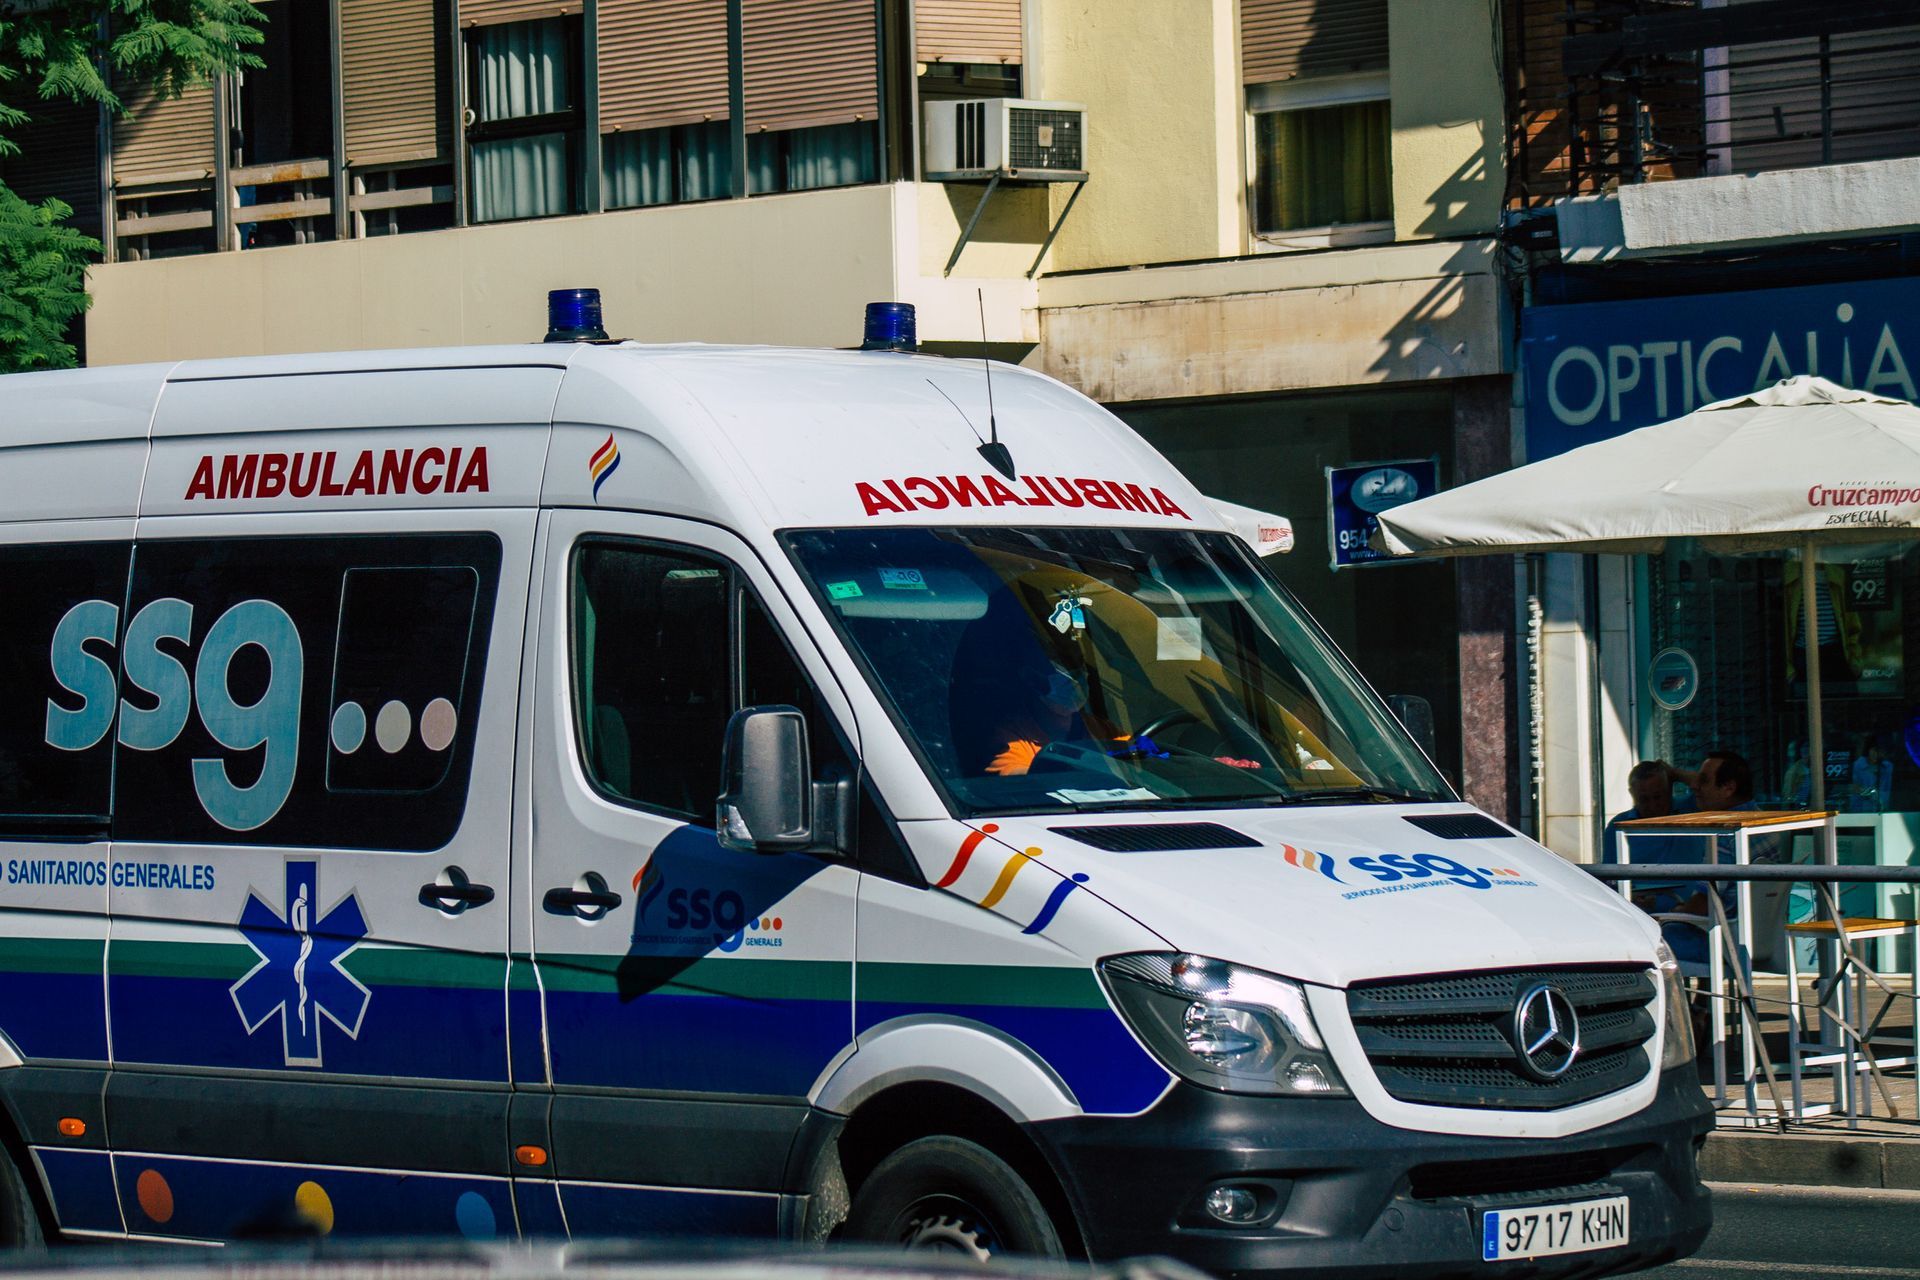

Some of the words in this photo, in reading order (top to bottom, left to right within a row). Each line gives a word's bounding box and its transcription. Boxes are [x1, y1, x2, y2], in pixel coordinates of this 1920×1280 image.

[184, 446, 489, 500] AMBULANCIA
[1807, 483, 1920, 506] Cruzcampo
[1825, 509, 1891, 525] ESPECIAL
[45, 597, 304, 831] ssg
[8, 859, 107, 886] SANITARIOS
[111, 862, 215, 891] GENERALES
[1349, 853, 1492, 890] ssg
[666, 887, 745, 953] ssg
[745, 937, 783, 947] GENERALES
[1505, 1211, 1573, 1252] 9717
[1582, 1203, 1624, 1244] KHN
